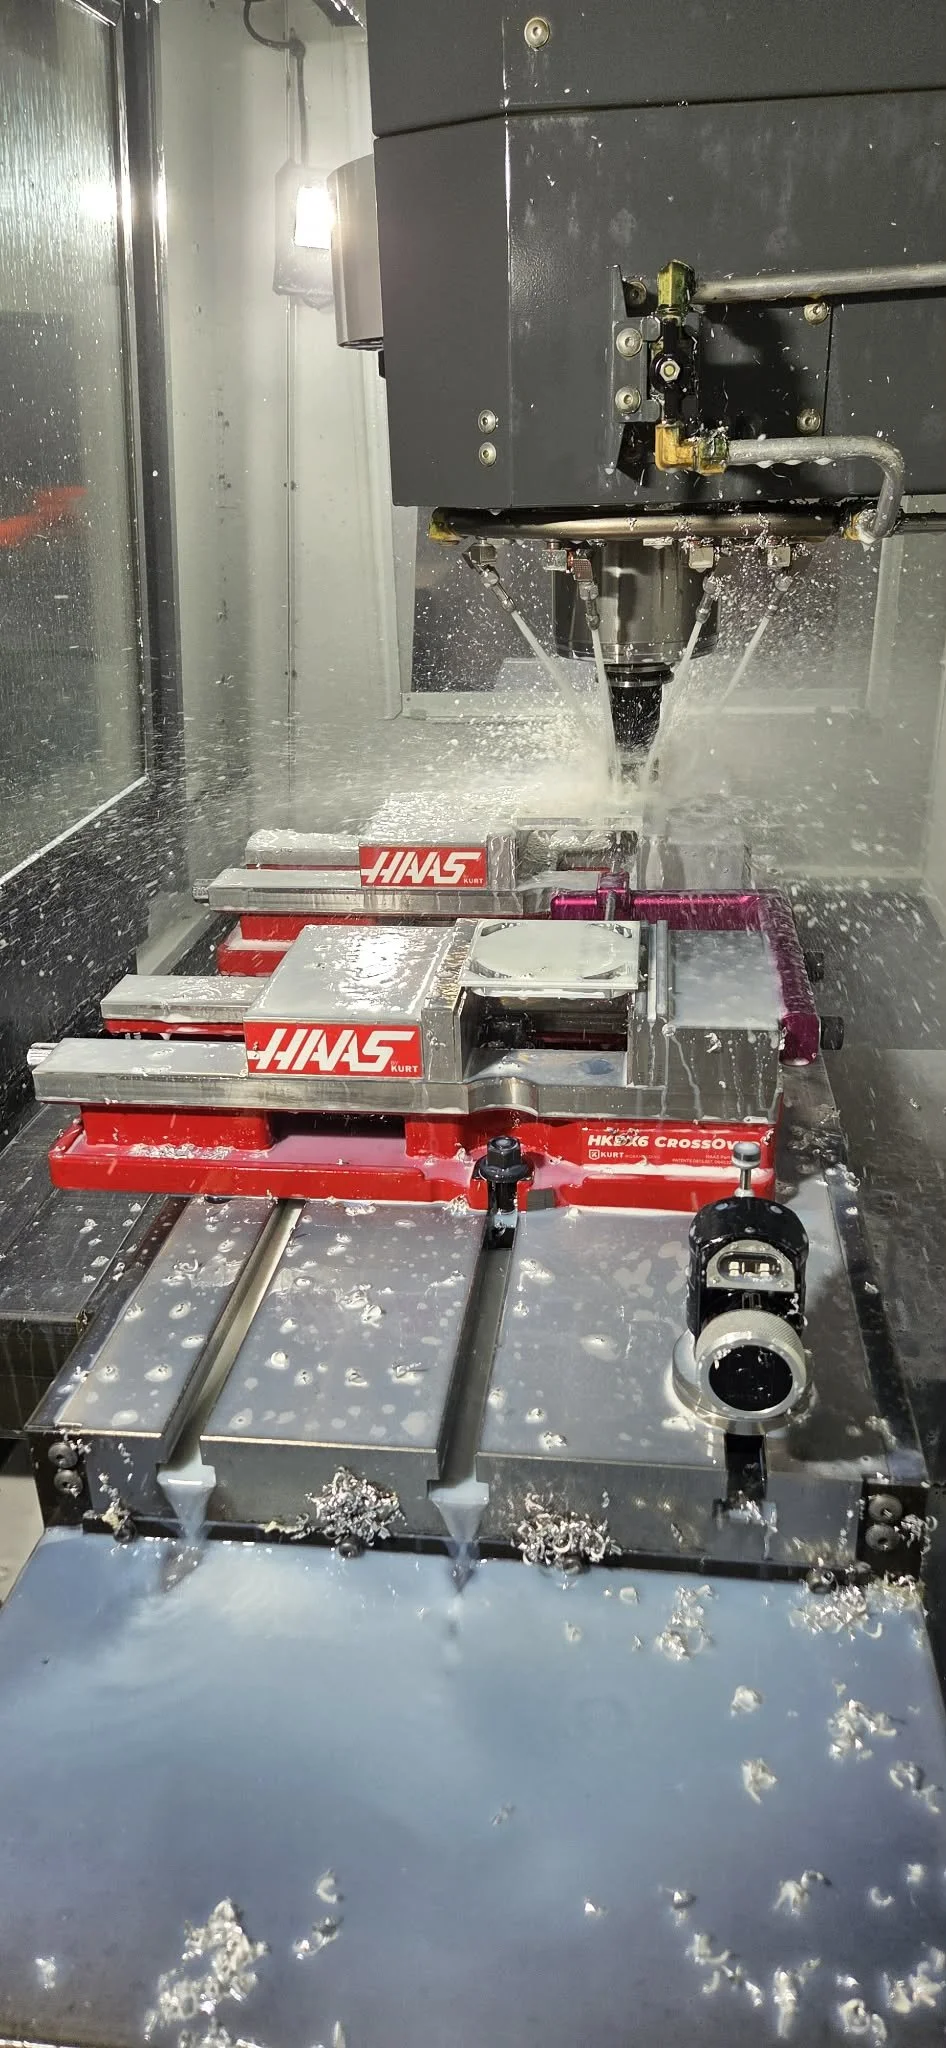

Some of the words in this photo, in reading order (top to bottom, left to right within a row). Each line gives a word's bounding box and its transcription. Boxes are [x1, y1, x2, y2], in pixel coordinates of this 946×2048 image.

[360, 851, 481, 884] HAAS
[247, 1028, 415, 1072] HAAS
[390, 1064, 419, 1073] KURT
[654, 1136, 761, 1150] CROSSOV
[600, 1151, 625, 1159] KURT
